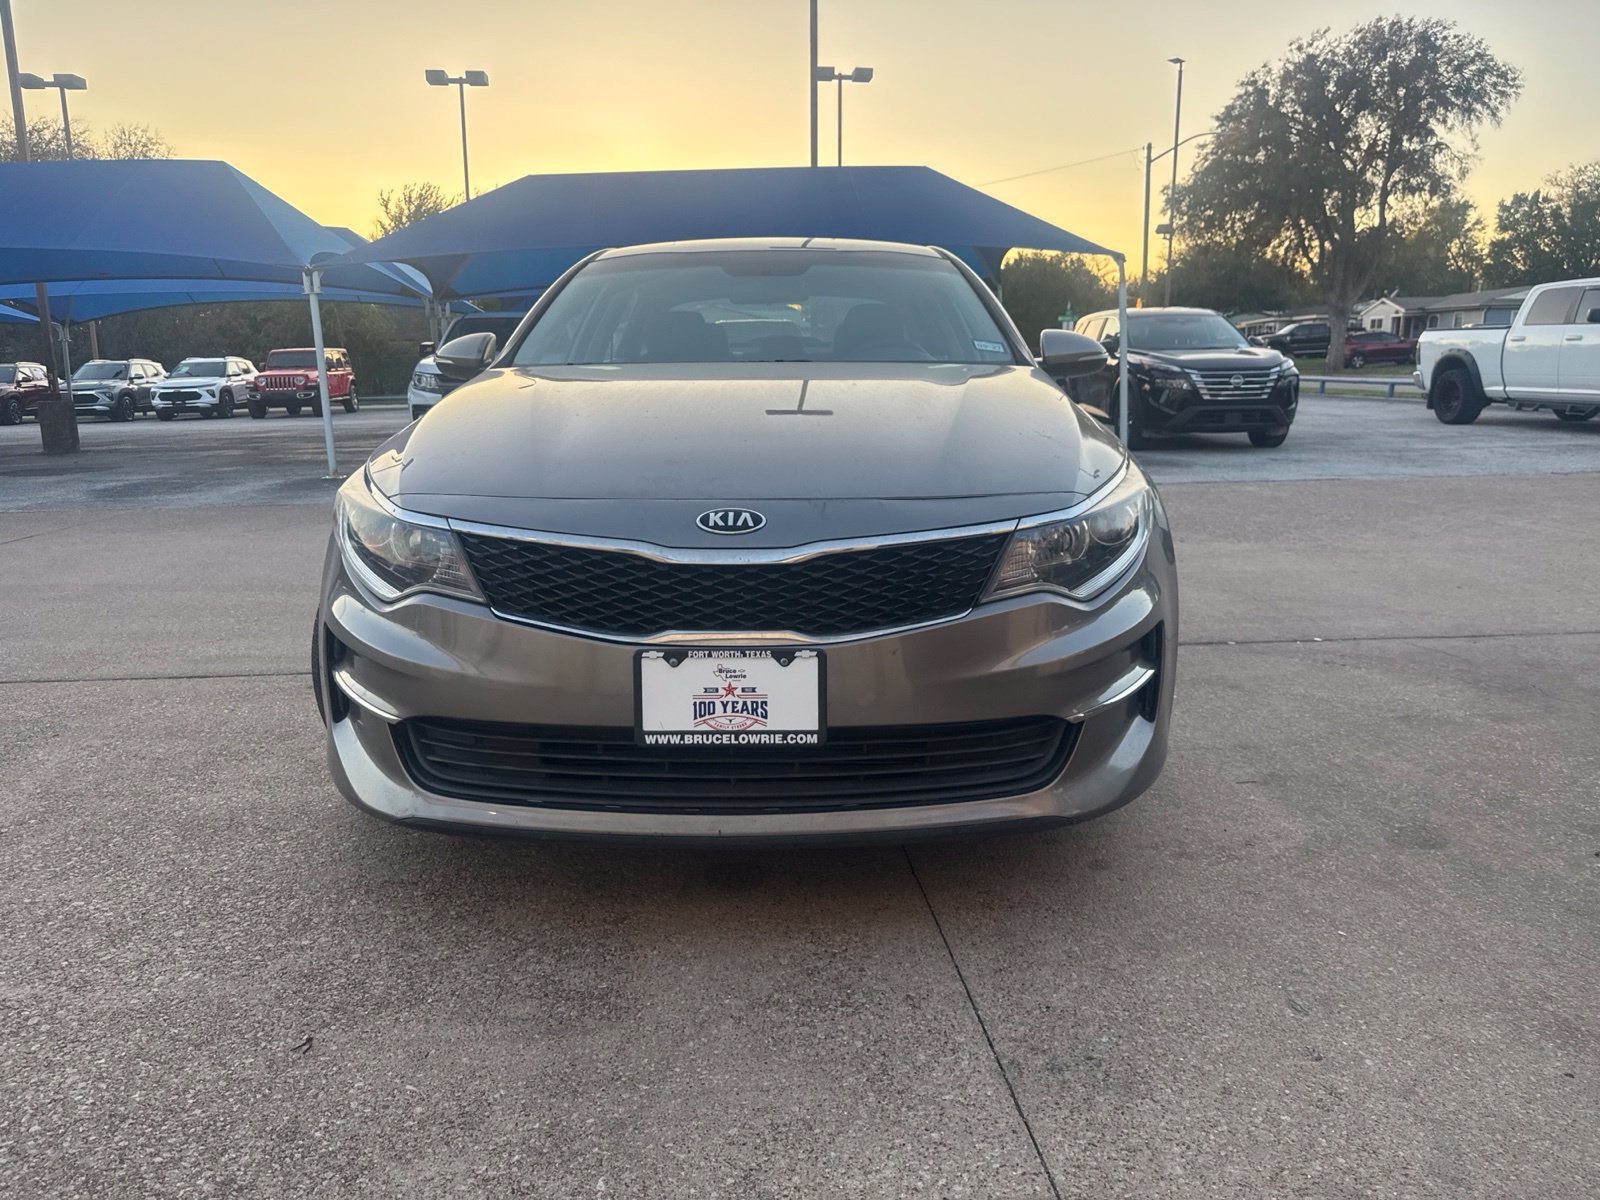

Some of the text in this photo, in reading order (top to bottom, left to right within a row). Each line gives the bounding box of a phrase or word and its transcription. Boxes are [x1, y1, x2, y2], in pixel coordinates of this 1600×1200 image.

[708, 511, 754, 526] KIA
[688, 650, 710, 658] FORT
[745, 650, 772, 658] TEXAS
[693, 700, 768, 721] 100 YEARS
[645, 733, 818, 744] WWW.BRUCELOWRIE.COM
